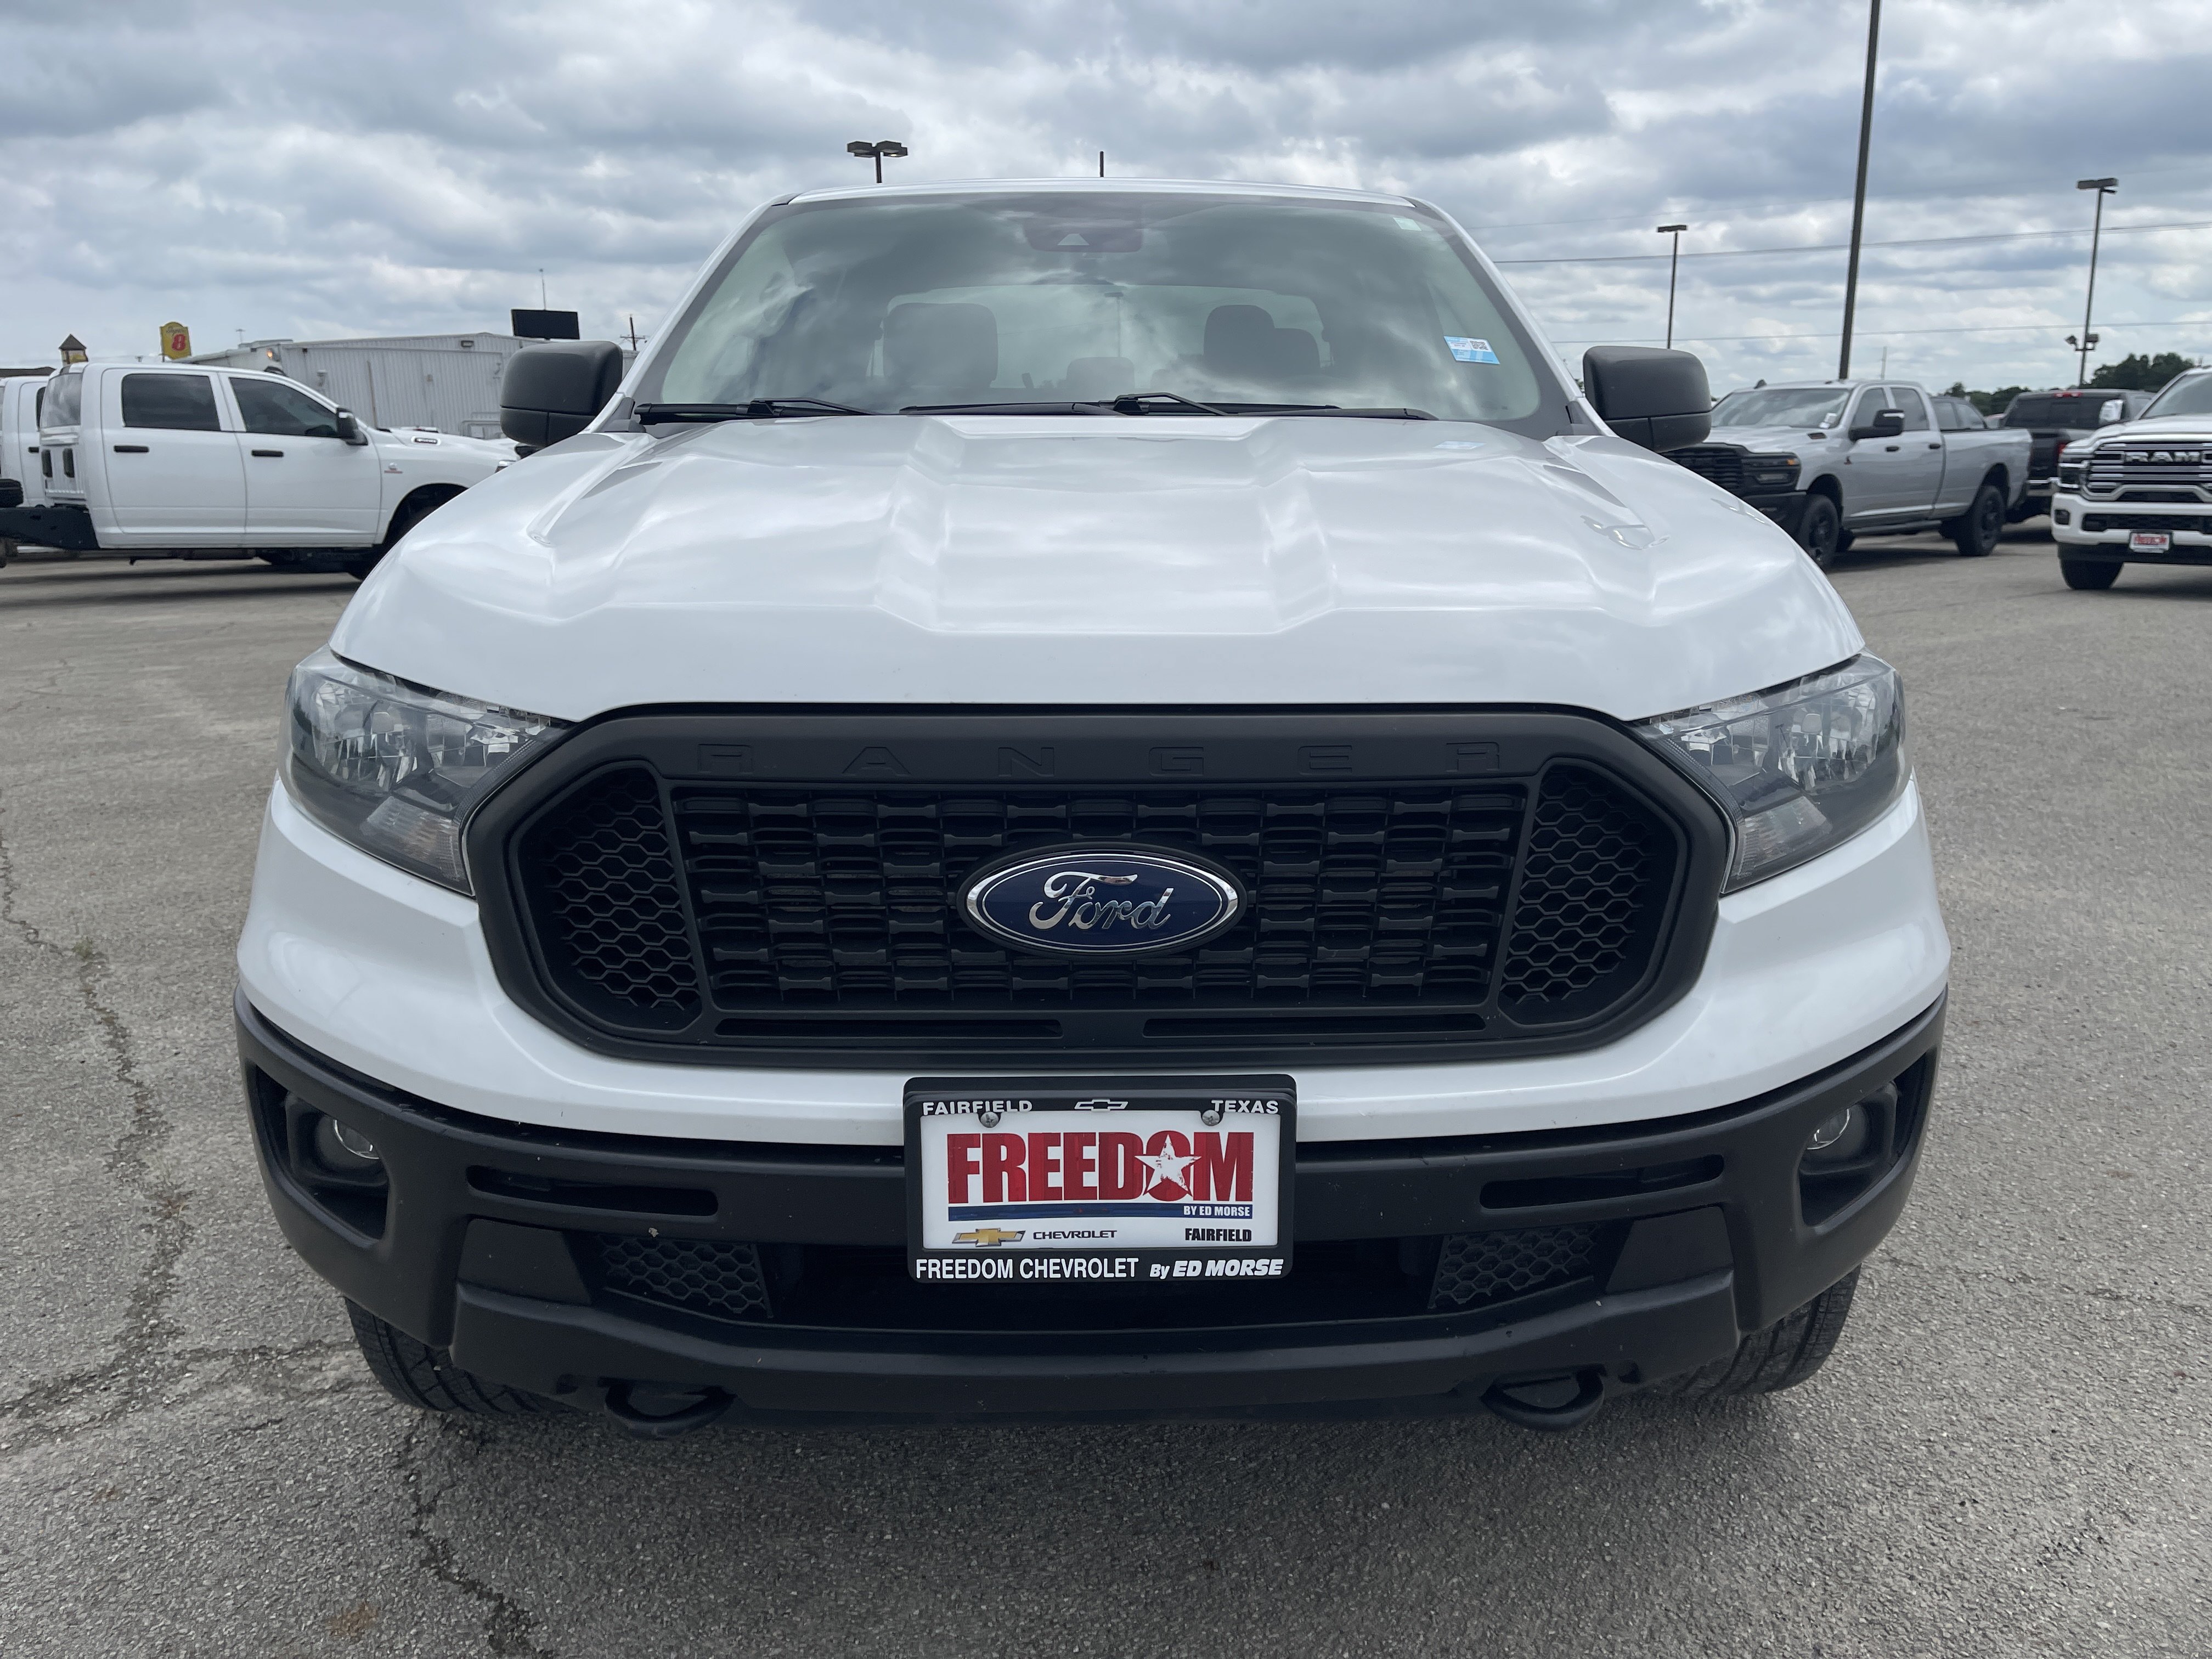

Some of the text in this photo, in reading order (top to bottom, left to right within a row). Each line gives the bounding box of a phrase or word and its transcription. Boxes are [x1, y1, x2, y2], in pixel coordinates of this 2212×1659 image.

[172, 333, 186, 351] 8
[2126, 451, 2200, 462] RAM
[698, 742, 1500, 777] RANGER
[1029, 871, 1173, 929] Ford
[923, 1101, 1032, 1115] FAIRFIELD
[1212, 1101, 1279, 1114] TEXAS
[947, 1130, 1254, 1204] FREEDOM
[1183, 1206, 1250, 1217] BY ED MORSE
[1033, 1230, 1117, 1239] CHEVROLET
[1185, 1228, 1251, 1242] FAIRFIELD
[916, 1258, 1284, 1279] FREEDOM CHEVROLET By ED MORSE
